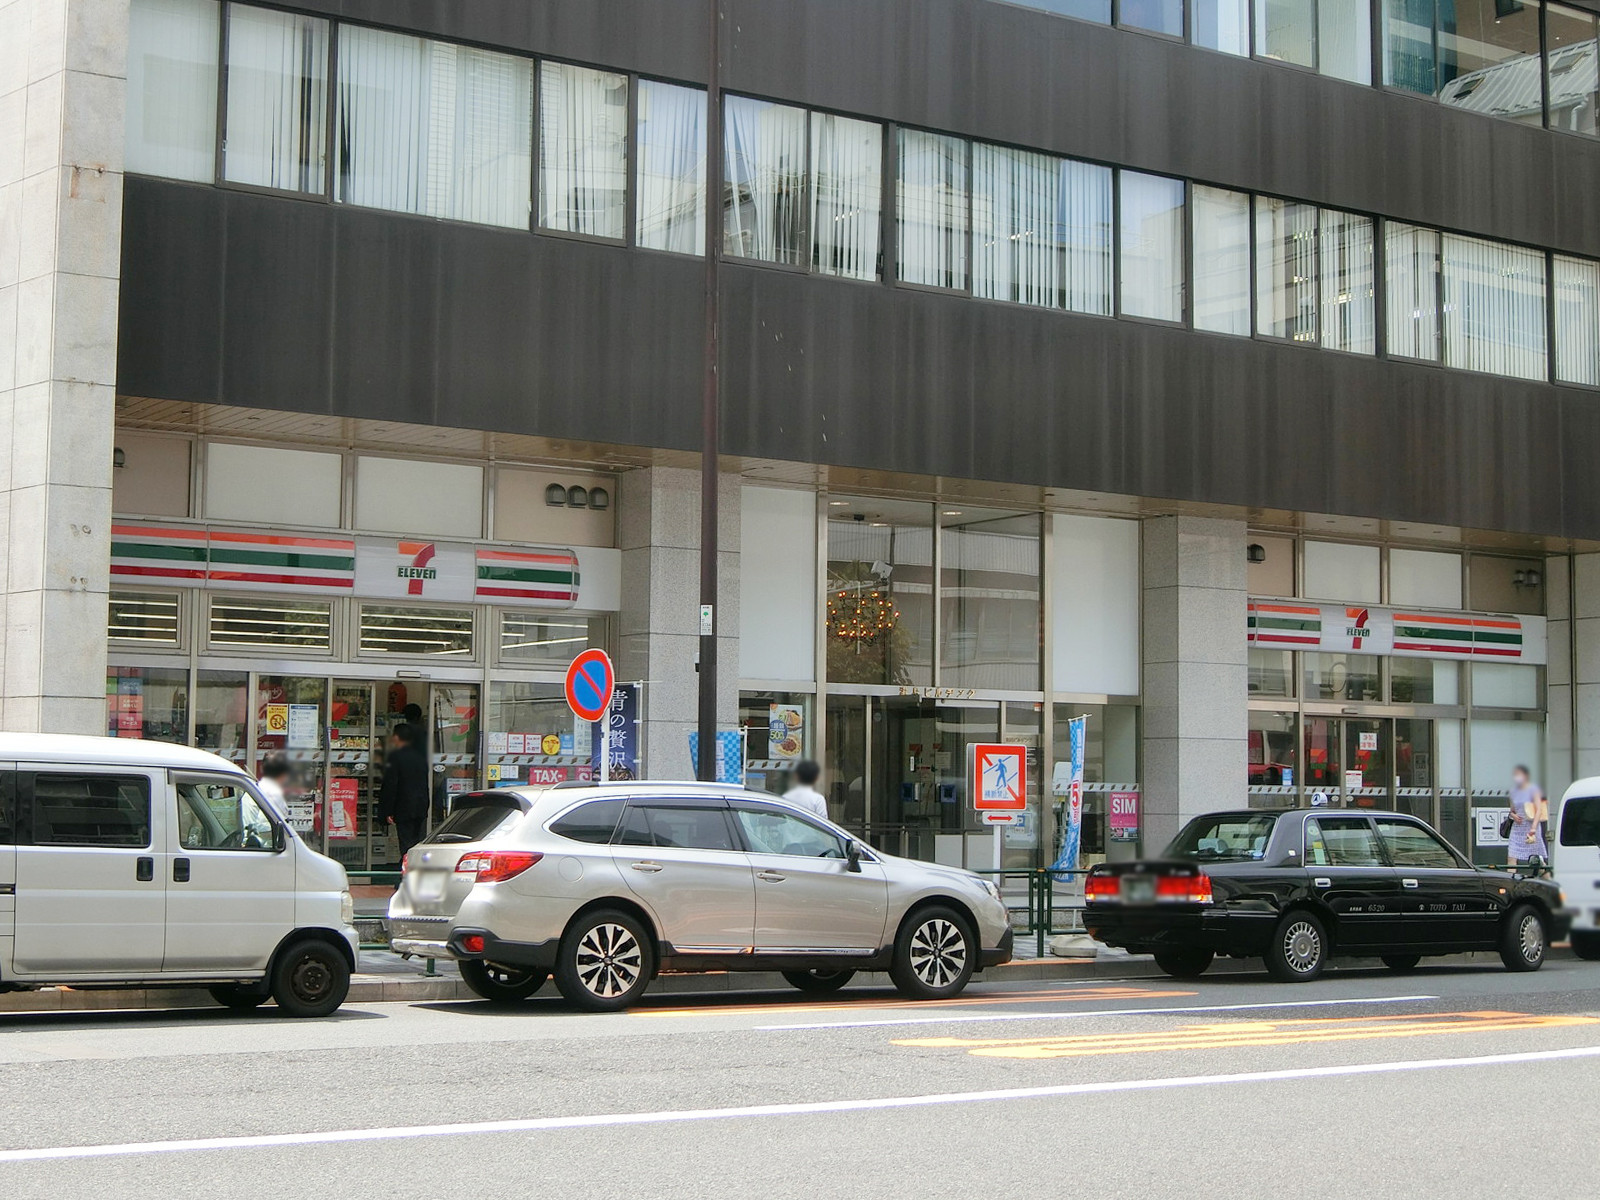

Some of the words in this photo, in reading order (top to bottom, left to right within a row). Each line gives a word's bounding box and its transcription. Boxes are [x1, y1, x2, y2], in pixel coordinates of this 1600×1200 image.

[534, 769, 563, 783] TAX-
[1112, 798, 1136, 814] SIM
[1452, 903, 1466, 911] TAXI
